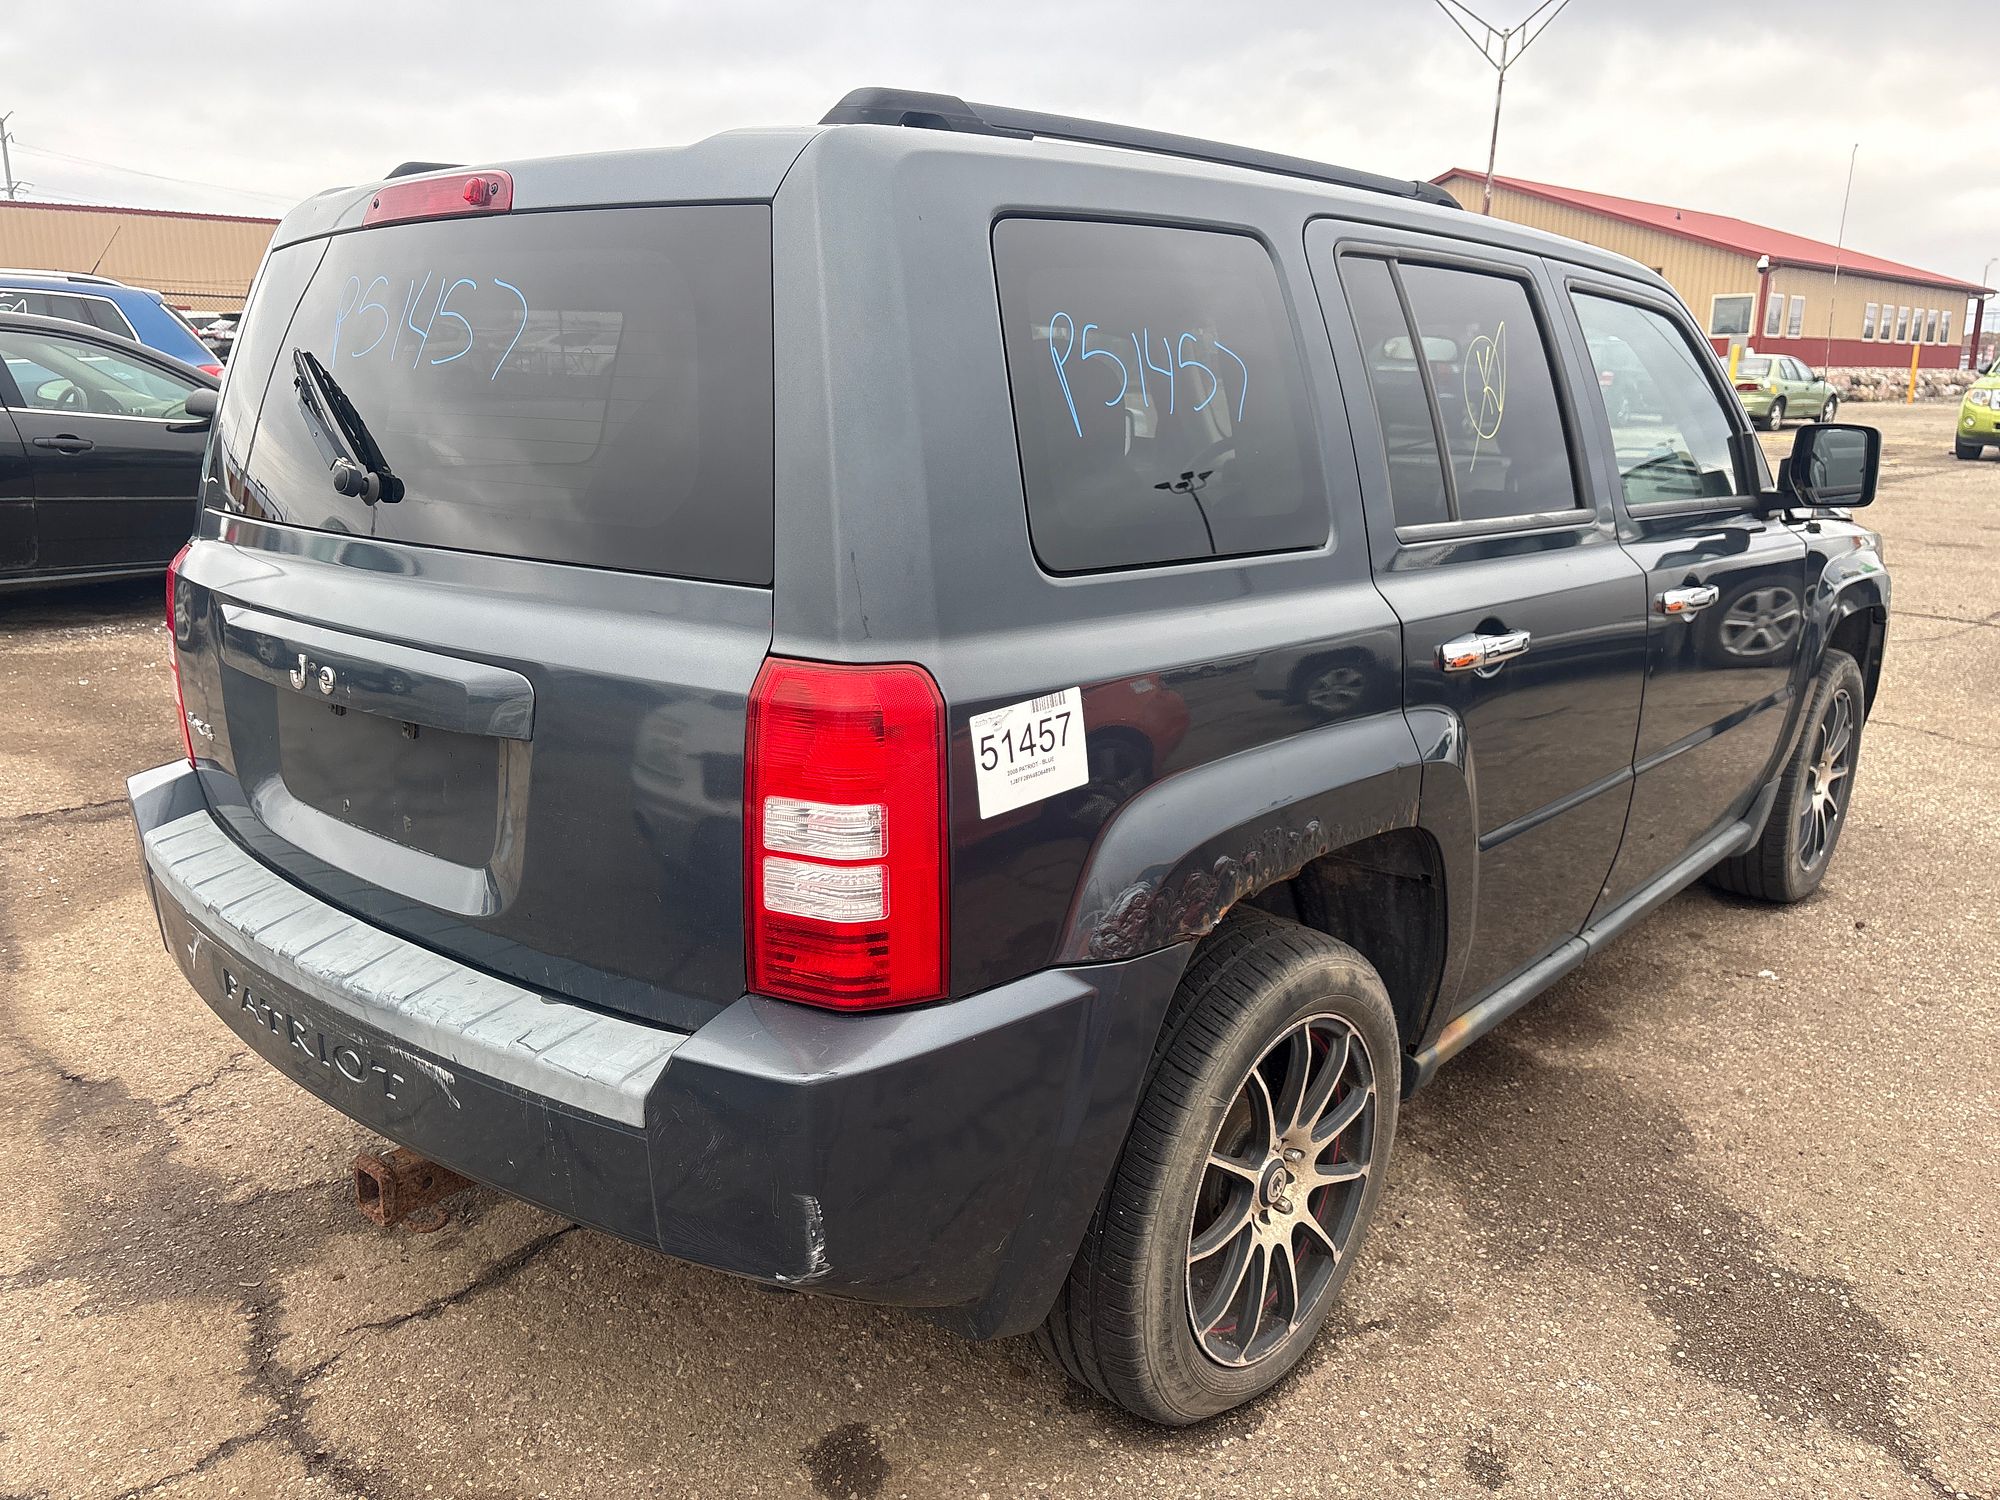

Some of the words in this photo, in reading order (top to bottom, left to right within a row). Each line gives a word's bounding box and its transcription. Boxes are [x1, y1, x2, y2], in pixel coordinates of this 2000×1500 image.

[330, 269, 528, 382] P51457
[1049, 311, 1248, 438] P51457
[980, 710, 1071, 772] 51457
[1018, 760, 1039, 773] PATRIOT
[1041, 756, 1055, 765] BLUE
[222, 967, 405, 1100] PATRIOT
